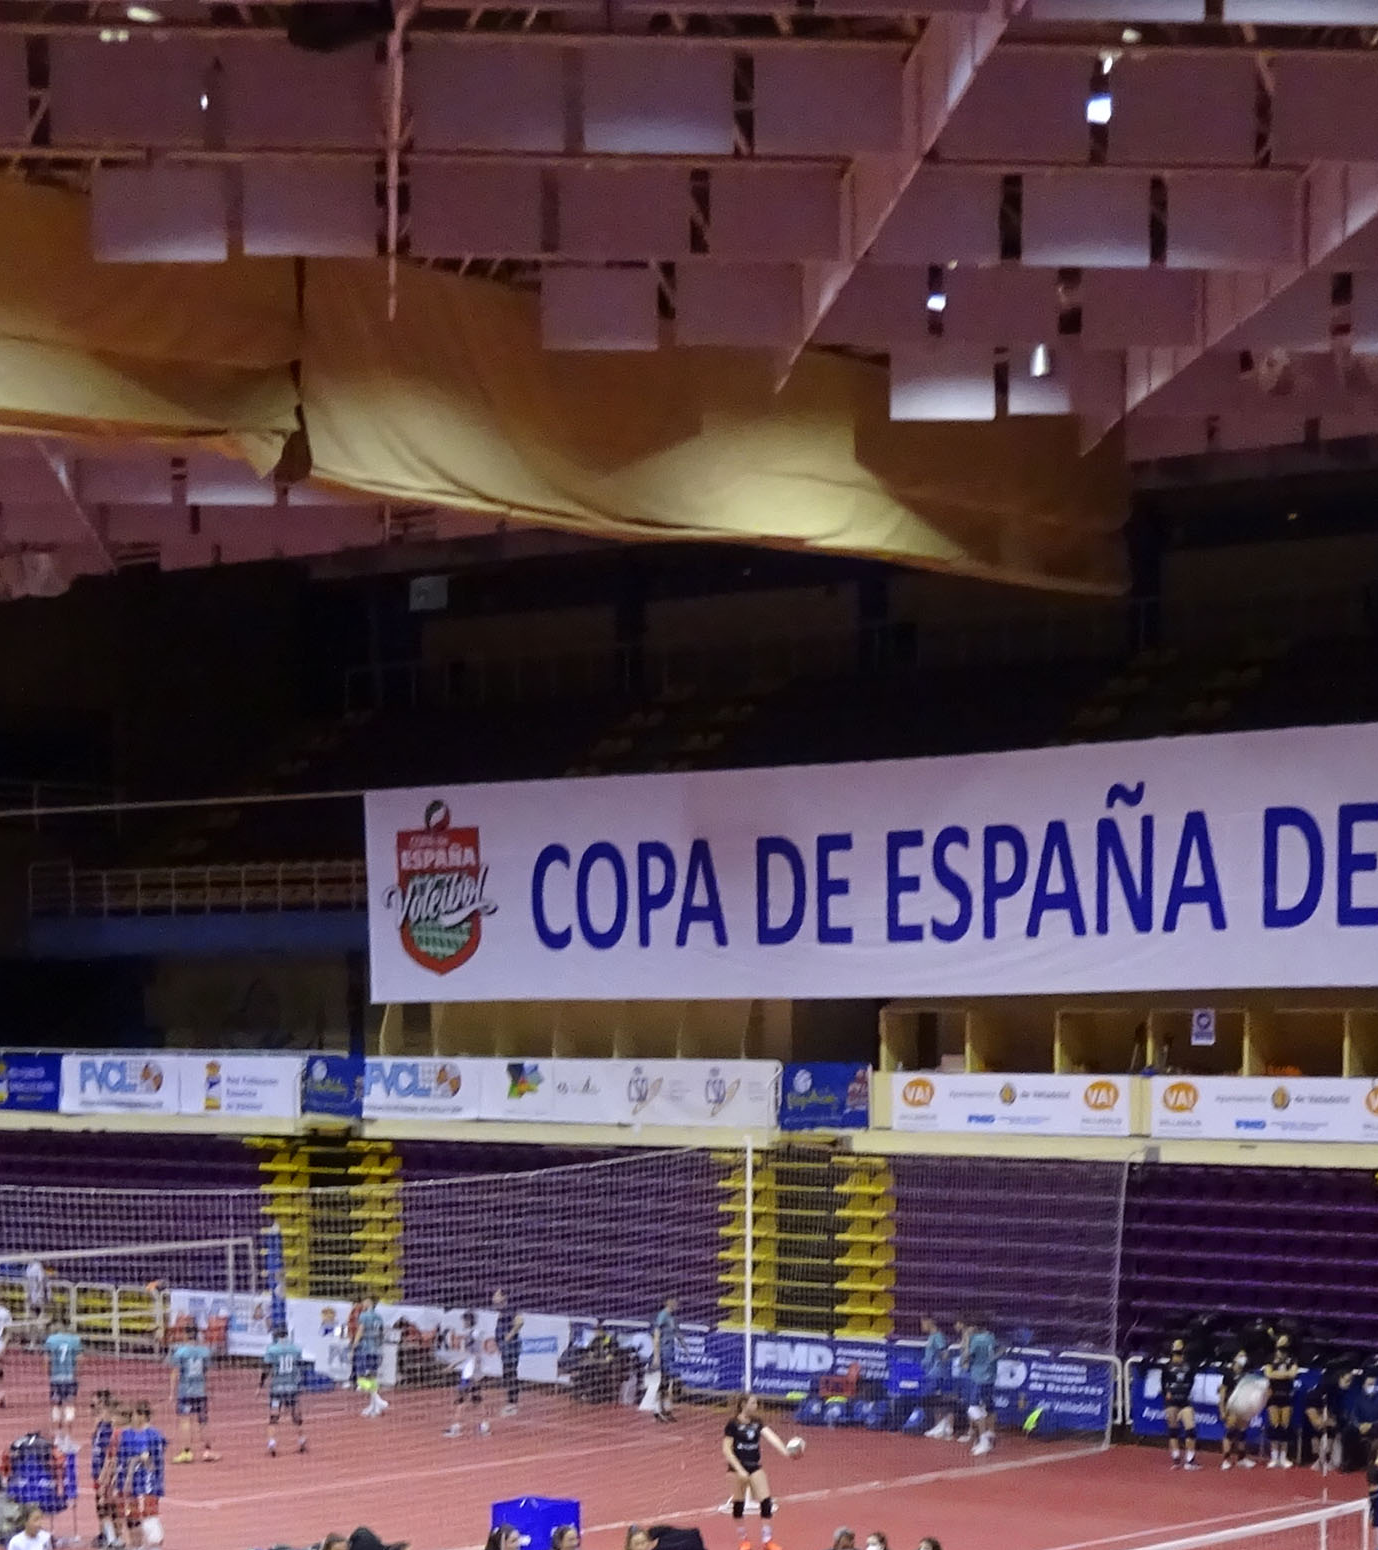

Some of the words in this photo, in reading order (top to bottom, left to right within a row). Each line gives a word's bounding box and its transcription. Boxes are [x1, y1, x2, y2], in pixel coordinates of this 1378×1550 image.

[400, 843, 477, 871] ESPAÑA
[530, 838, 730, 951] COPA
[755, 833, 854, 945] DE
[885, 781, 1228, 943] ESPAÑA
[383, 864, 498, 930] Voleibol
[754, 1341, 834, 1373] FMD
